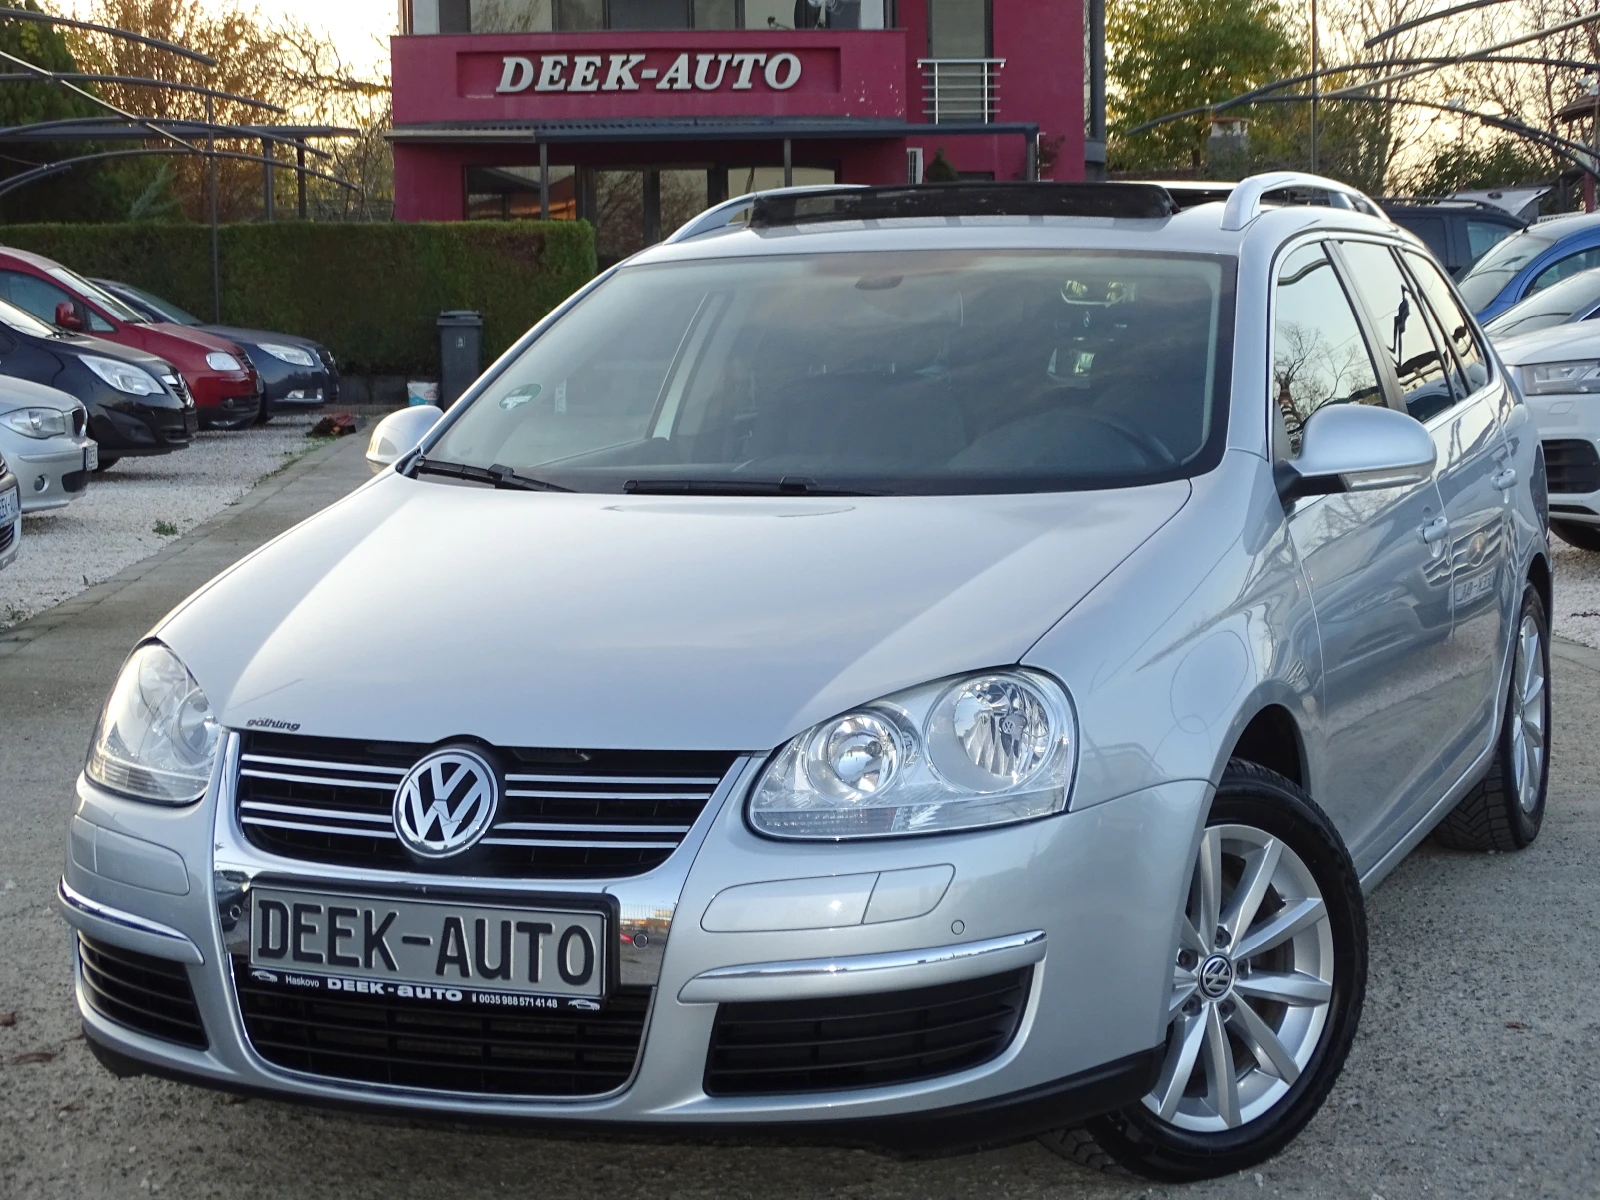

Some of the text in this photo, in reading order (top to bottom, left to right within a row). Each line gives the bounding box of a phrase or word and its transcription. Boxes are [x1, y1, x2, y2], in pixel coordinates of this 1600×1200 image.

[496, 52, 802, 93] DEEK-AUTO
[258, 899, 596, 987] DEEK-AUTO
[285, 974, 320, 988] Haskovo
[479, 993, 501, 1004] 0035
